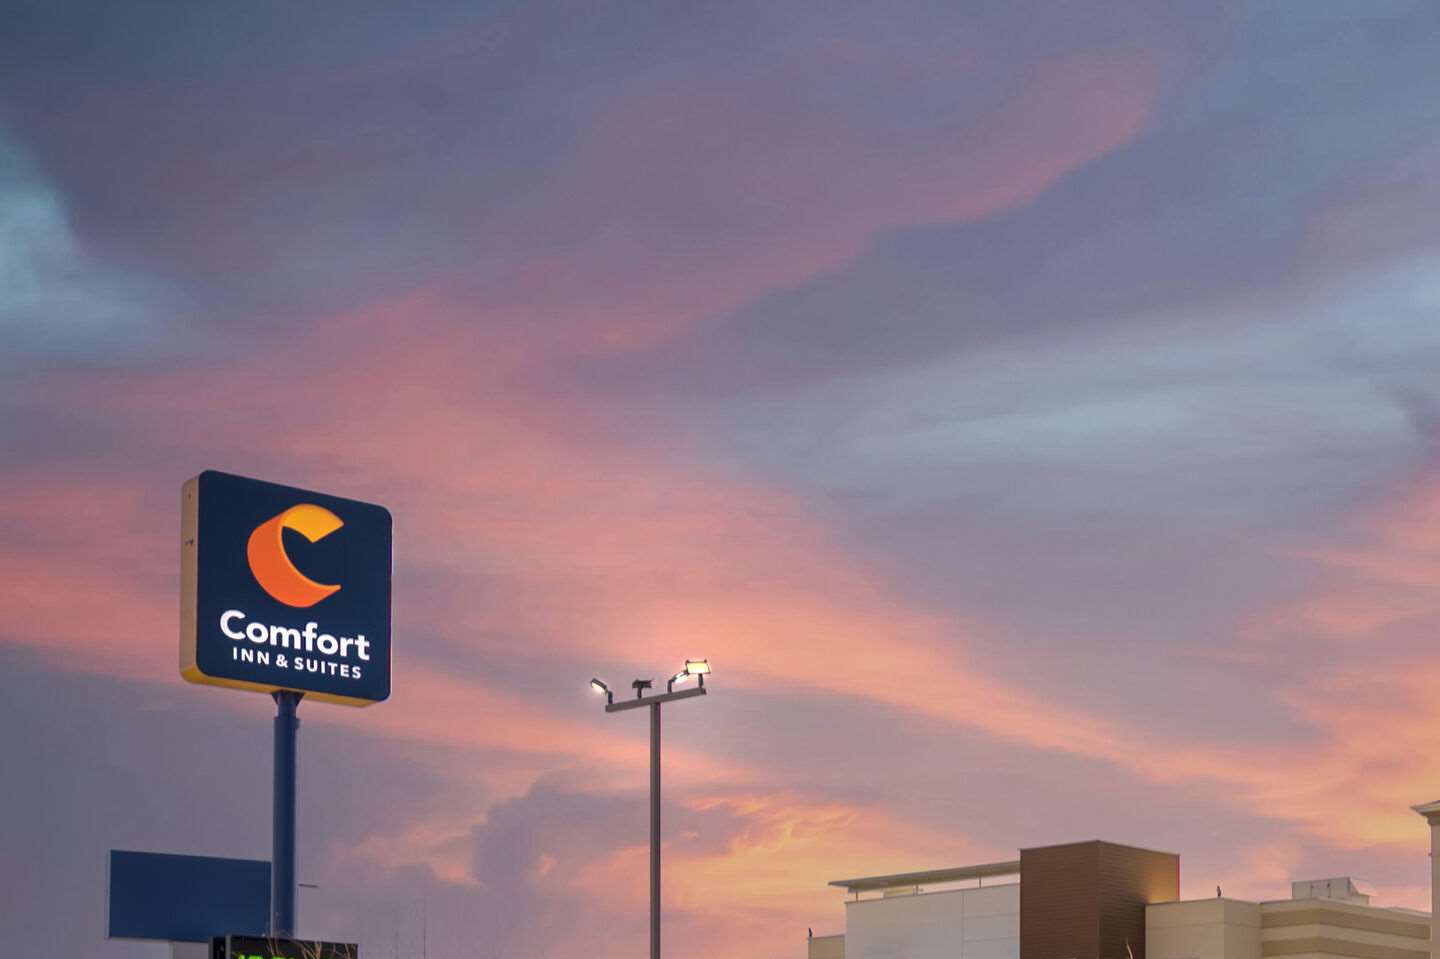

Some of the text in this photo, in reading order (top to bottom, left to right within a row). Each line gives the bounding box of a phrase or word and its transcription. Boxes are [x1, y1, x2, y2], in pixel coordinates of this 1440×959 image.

[219, 609, 370, 661] Comfort
[232, 646, 362, 679] INN & SUITES
